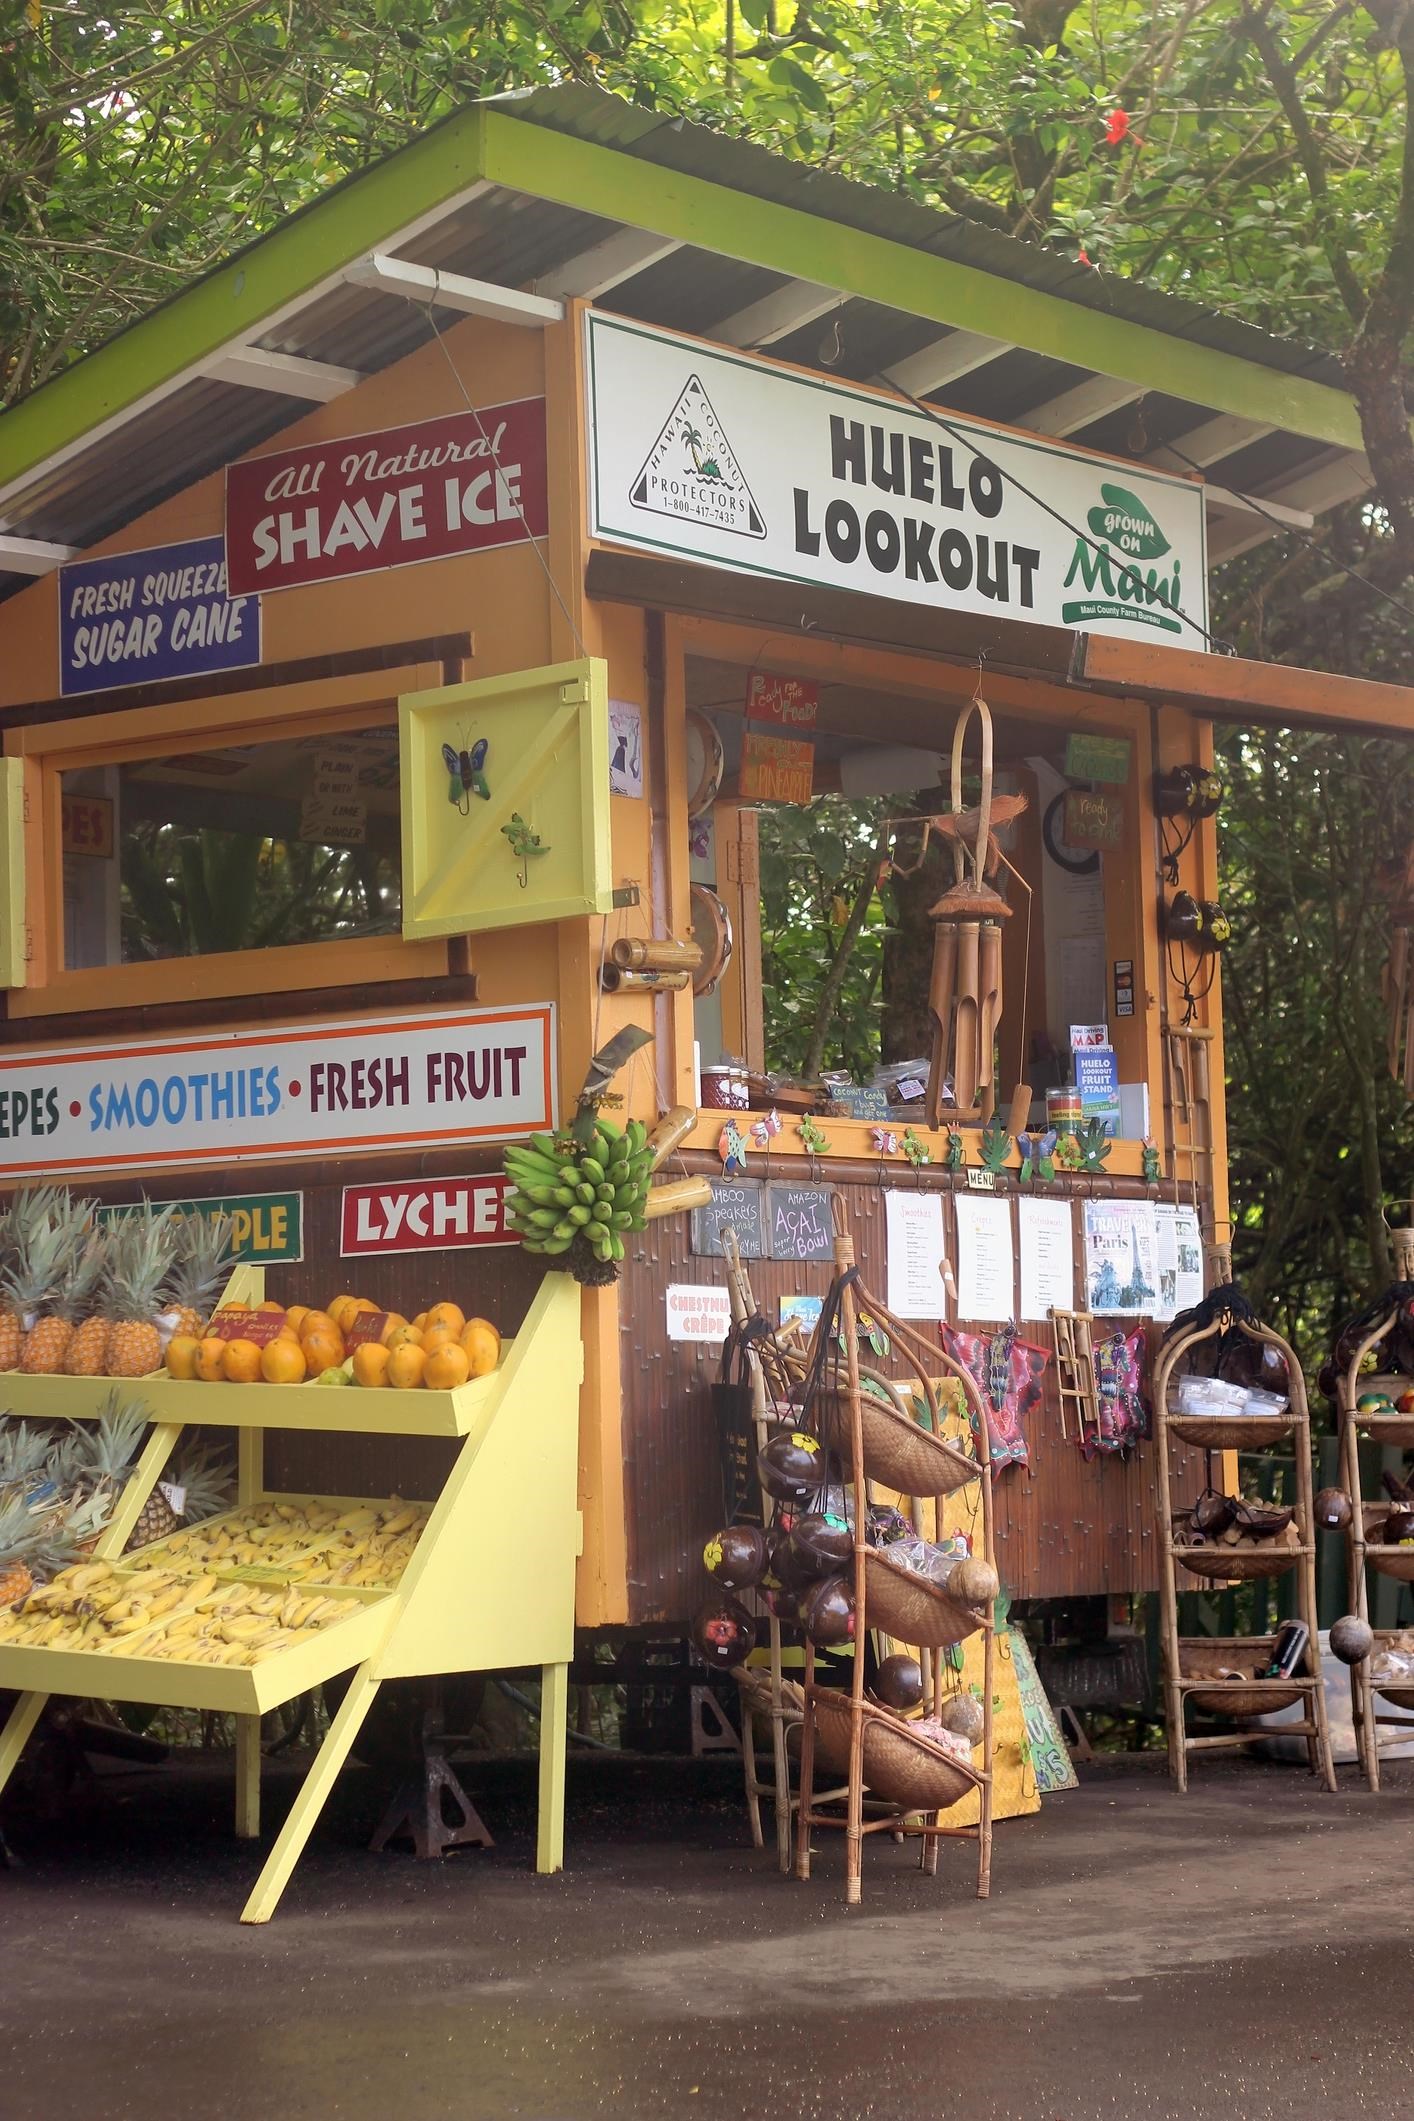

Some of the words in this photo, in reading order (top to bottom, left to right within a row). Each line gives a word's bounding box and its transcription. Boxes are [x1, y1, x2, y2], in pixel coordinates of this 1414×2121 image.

[650, 397, 691, 470] HAWAII
[700, 402, 745, 492] COCONUT
[264, 460, 326, 502] All
[340, 421, 507, 486] Natural
[829, 414, 1003, 518] HUELO
[651, 475, 745, 512] PROTECTORS
[252, 484, 427, 571] SHAVE
[444, 463, 525, 532] ICE
[663, 497, 735, 525] 1-800-417-7435
[1104, 513, 1155, 534] grown
[793, 487, 1040, 609] LOOKOUT
[1120, 534, 1141, 552] on
[1063, 538, 1182, 610] Maui
[70, 577, 136, 620] FRESH
[140, 561, 227, 607] SQUEEZE
[1080, 605, 1096, 615] Maui
[1097, 606, 1119, 617] County
[1120, 608, 1137, 619] Farm
[1138, 611, 1161, 624] Bureau
[71, 614, 163, 669] SUGAR
[170, 598, 248, 652] CANE
[1073, 1033, 1105, 1046] MAP
[1081, 1059, 1111, 1068] HUELO
[88, 1064, 282, 1133] SMOOTHIES
[309, 1056, 409, 1113] FRESH
[427, 1046, 528, 1102] FRUIT
[1081, 1075, 1111, 1085] FRUIT
[1083, 1085, 1113, 1094] STAND
[970, 1171, 993, 1186] MENU
[787, 1191, 827, 1205] AMAZON
[1092, 1234, 1129, 1249] Paris
[669, 1294, 730, 1312] CHESTNU
